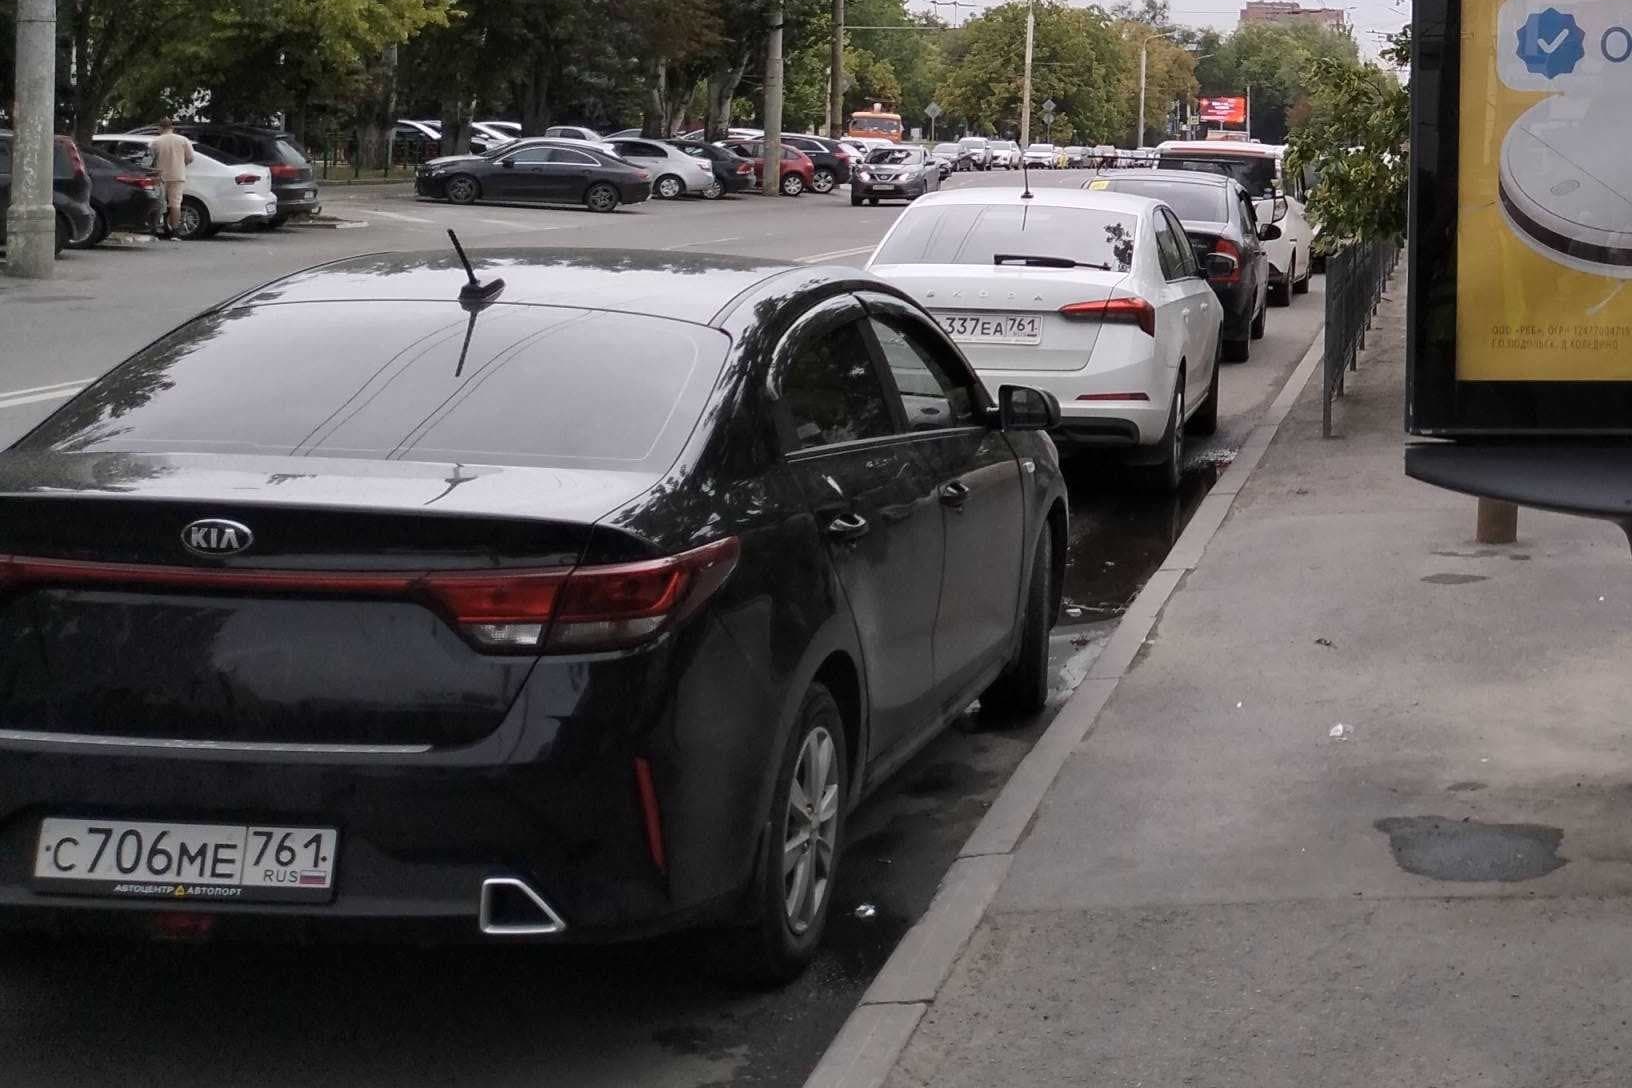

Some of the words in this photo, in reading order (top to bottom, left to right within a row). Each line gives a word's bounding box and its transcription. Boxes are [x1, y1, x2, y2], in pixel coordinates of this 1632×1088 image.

[937, 316, 1004, 336] 337ЕА
[1008, 318, 1037, 332] 761
[191, 526, 240, 549] KIA
[53, 827, 238, 879] С706МЕ
[253, 830, 322, 868] 761
[263, 869, 299, 883] RUS
[113, 883, 175, 894] АВТОЦЕНТР
